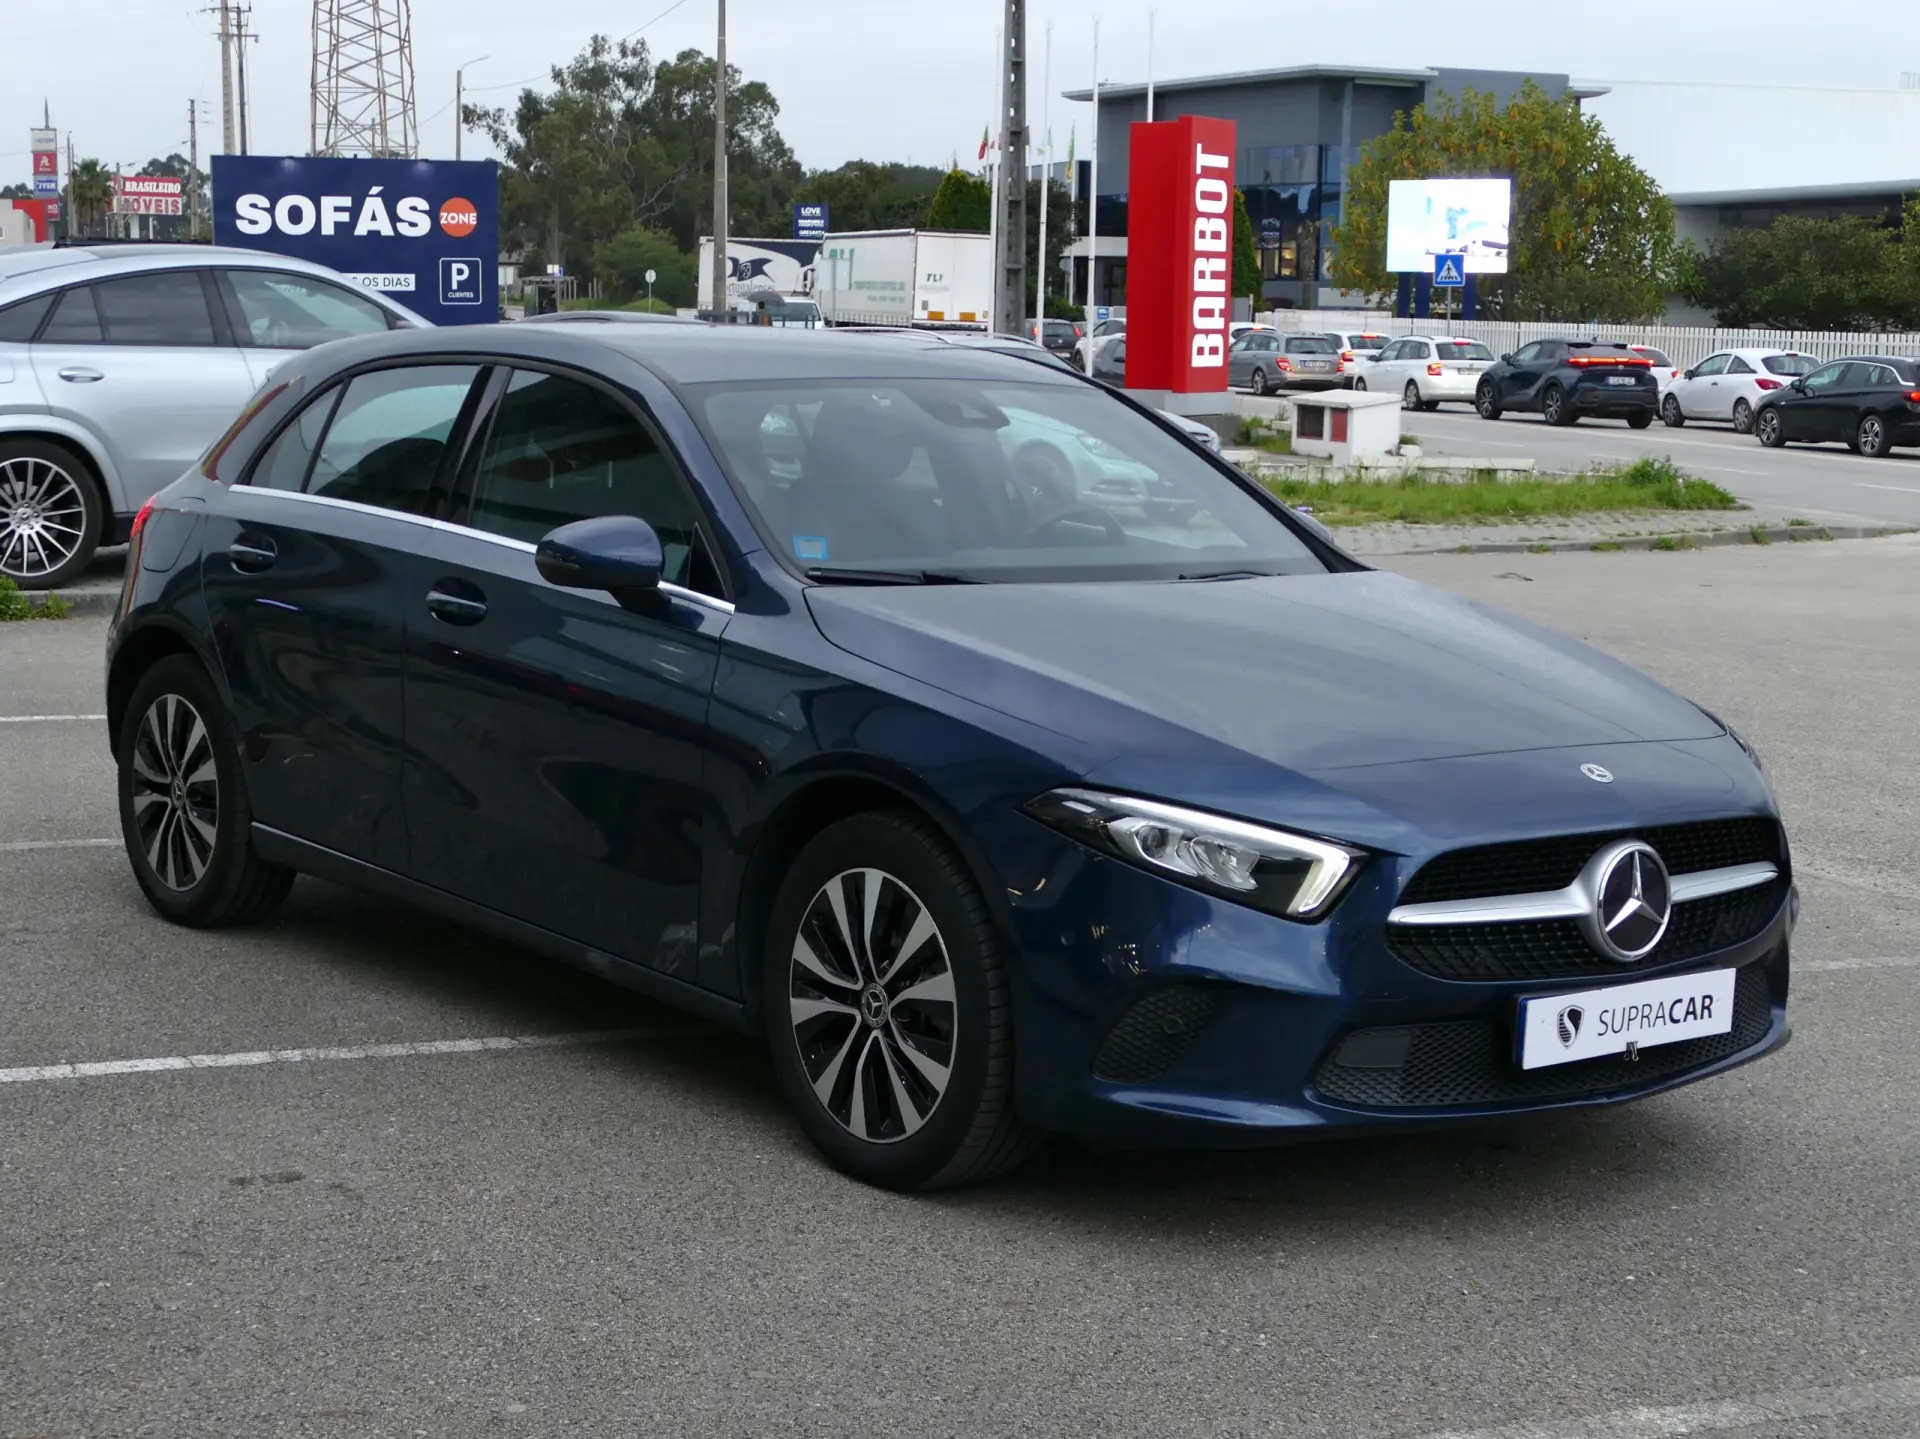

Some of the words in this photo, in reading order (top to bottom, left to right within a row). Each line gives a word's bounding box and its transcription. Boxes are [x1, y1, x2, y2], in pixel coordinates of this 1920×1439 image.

[125, 181, 181, 194] BRASILEIRO
[236, 186, 432, 237] SOFÁS
[440, 212, 477, 225] ZONE
[801, 206, 821, 214] LOVE
[1191, 143, 1229, 368] BARBOT
[362, 277, 379, 287] OS
[383, 277, 410, 287] DIAS
[451, 263, 470, 290] P
[1597, 994, 1714, 1036] SUPRACAR
